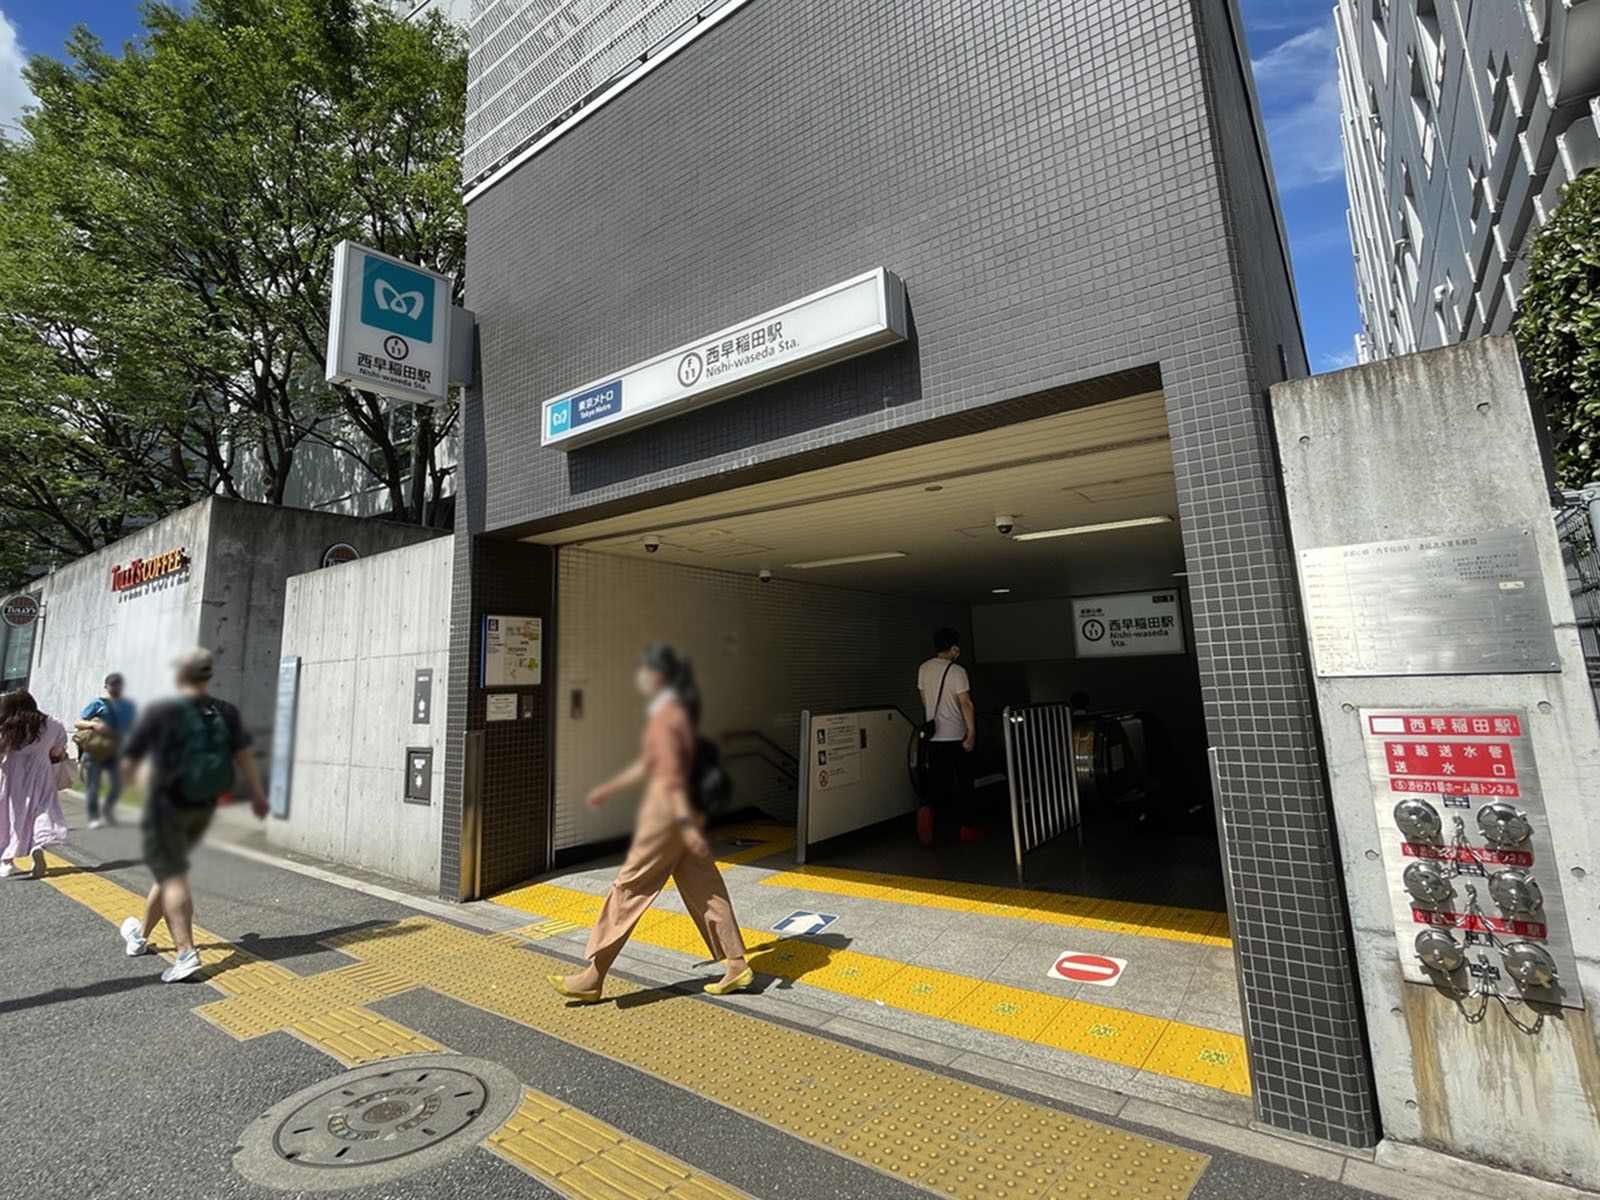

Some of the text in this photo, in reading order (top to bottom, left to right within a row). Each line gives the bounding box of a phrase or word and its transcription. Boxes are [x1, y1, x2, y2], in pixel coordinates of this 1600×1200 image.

[706, 321, 784, 365] 西早稲田駅
[778, 338, 800, 353] Sta.
[357, 352, 431, 384] 西早稲田駅
[687, 358, 693, 368] F
[684, 368, 696, 380] 11
[578, 389, 614, 411] 東京メトロ
[142, 546, 182, 581] COFFEE
[1109, 616, 1175, 631] 西早稲田駅
[1409, 718, 1513, 734] 西早稲田駅
